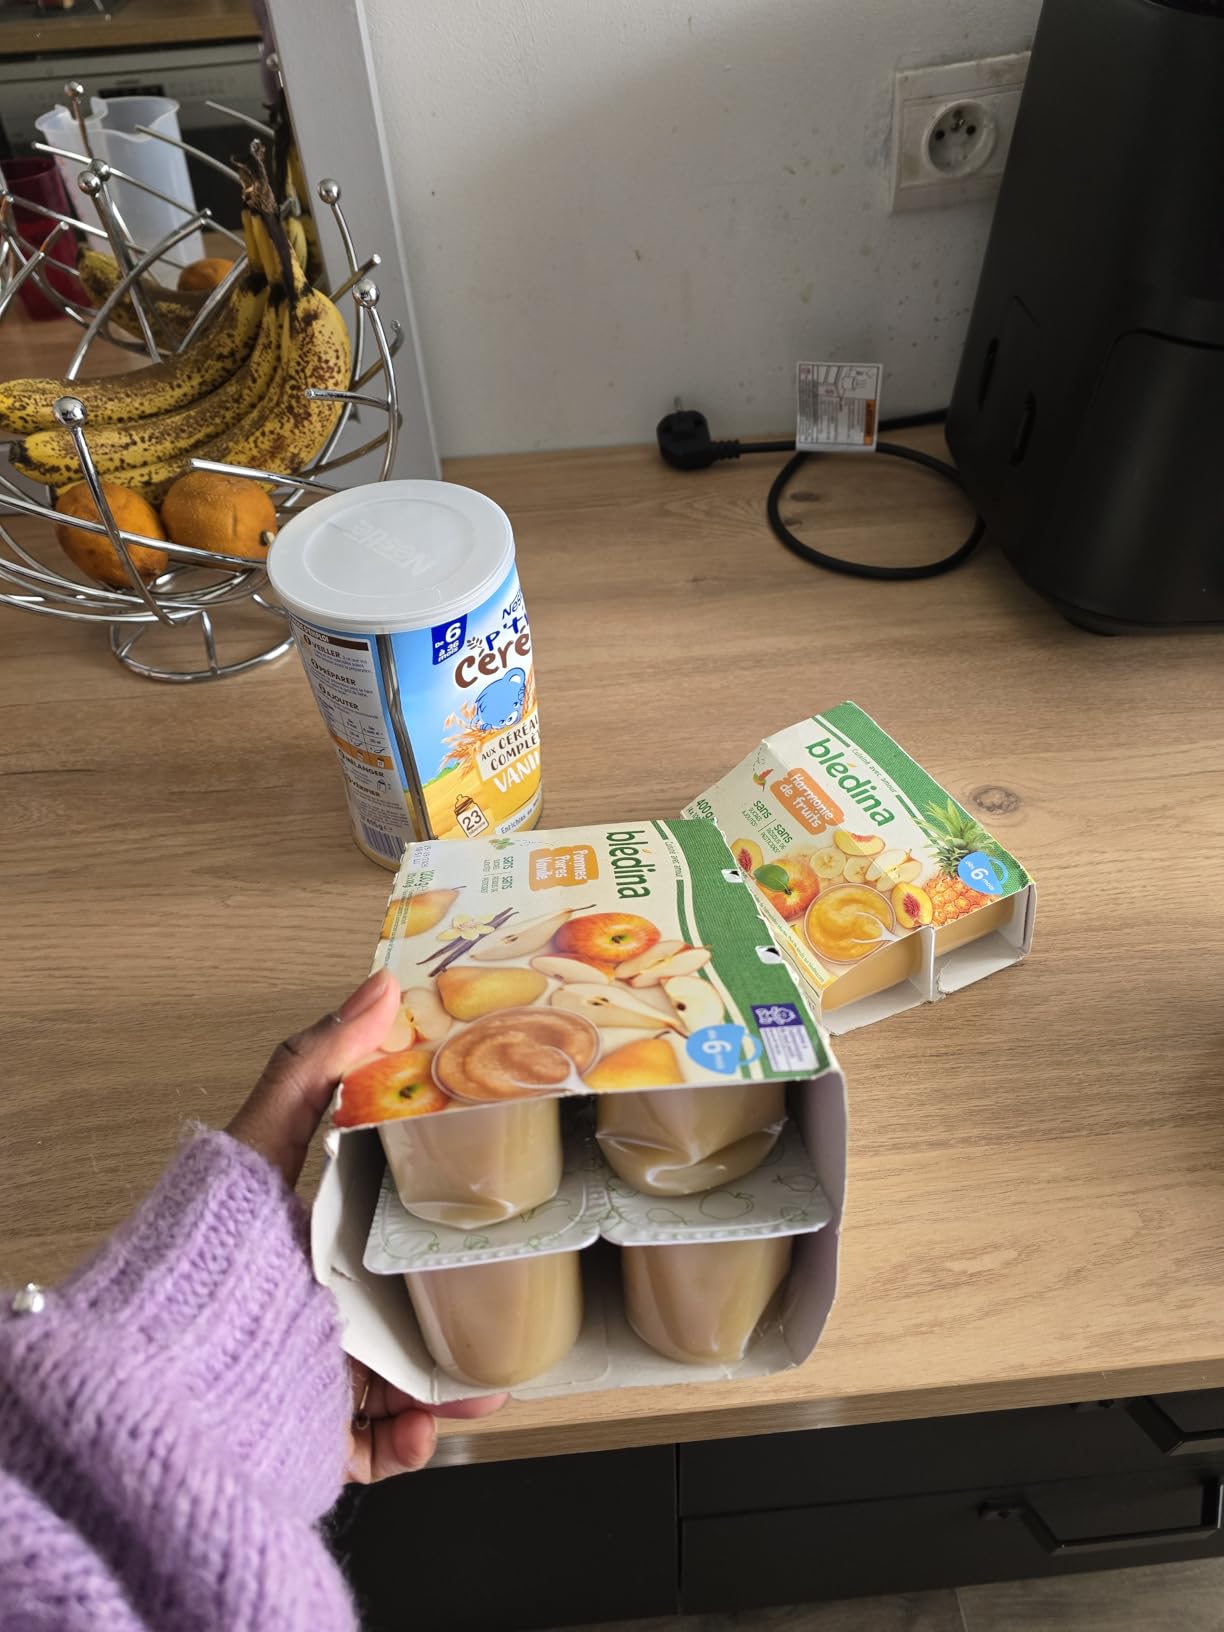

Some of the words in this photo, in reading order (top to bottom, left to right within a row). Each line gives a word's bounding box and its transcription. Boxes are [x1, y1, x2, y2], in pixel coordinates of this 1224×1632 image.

[445, 622, 461, 643] 6
[438, 647, 459, 662] mois
[481, 748, 497, 761] AUX
[490, 732, 539, 771] COMPLÈ
[805, 738, 895, 827] blédina
[780, 783, 793, 797] de
[793, 796, 822, 827] fruits
[791, 773, 833, 820] Harmonie
[753, 800, 772, 819] sans
[462, 810, 482, 832] 23
[500, 813, 527, 834] Enrichies
[774, 823, 793, 843] sans
[503, 855, 514, 870] sans
[535, 857, 553, 881] Vanille
[555, 855, 572, 879] Poires
[573, 849, 589, 880] Pommes
[606, 830, 657, 899] blédina
[502, 875, 513, 890] sans
[971, 868, 989, 880] 6
[702, 1040, 732, 1054] 6
